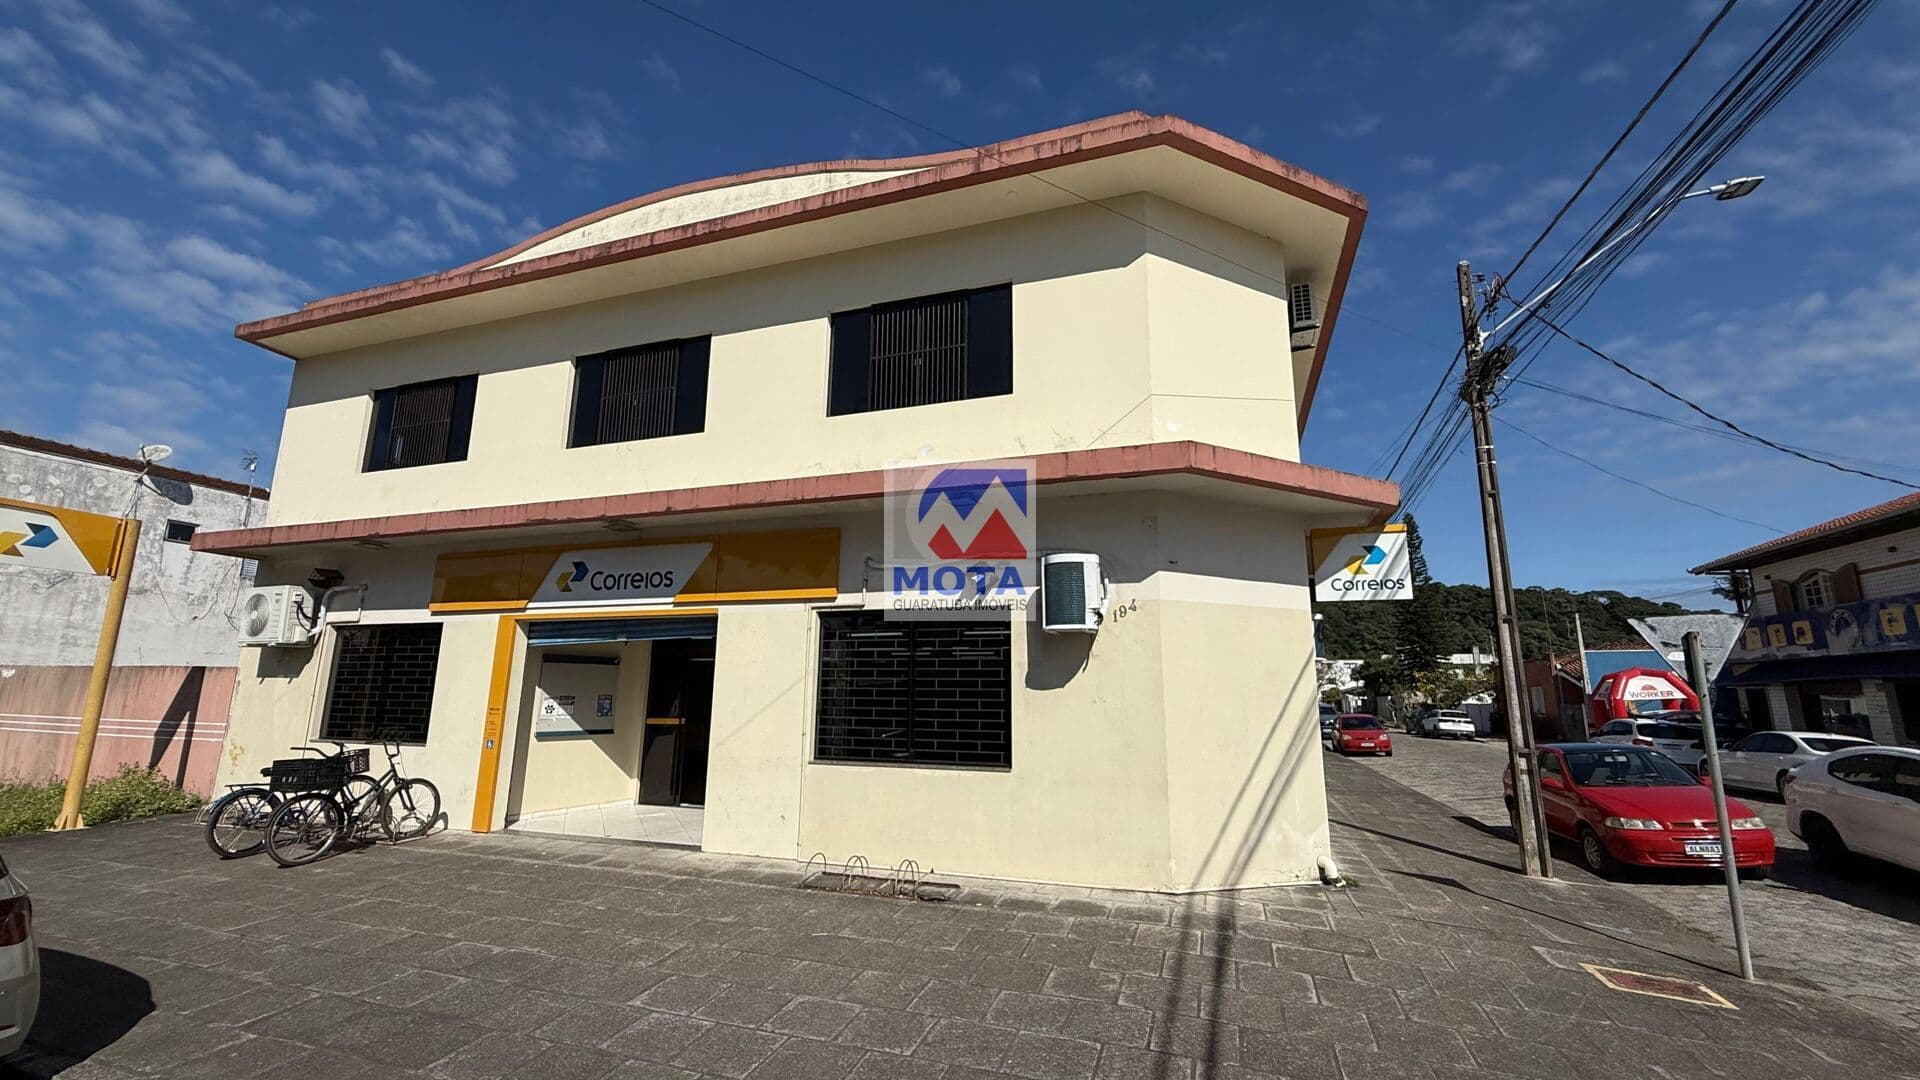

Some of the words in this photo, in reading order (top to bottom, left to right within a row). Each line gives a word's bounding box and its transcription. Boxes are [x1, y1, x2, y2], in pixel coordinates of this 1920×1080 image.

[590, 570, 674, 592] Correios
[1331, 578, 1405, 592] Correios
[1628, 690, 1674, 698] WORKER
